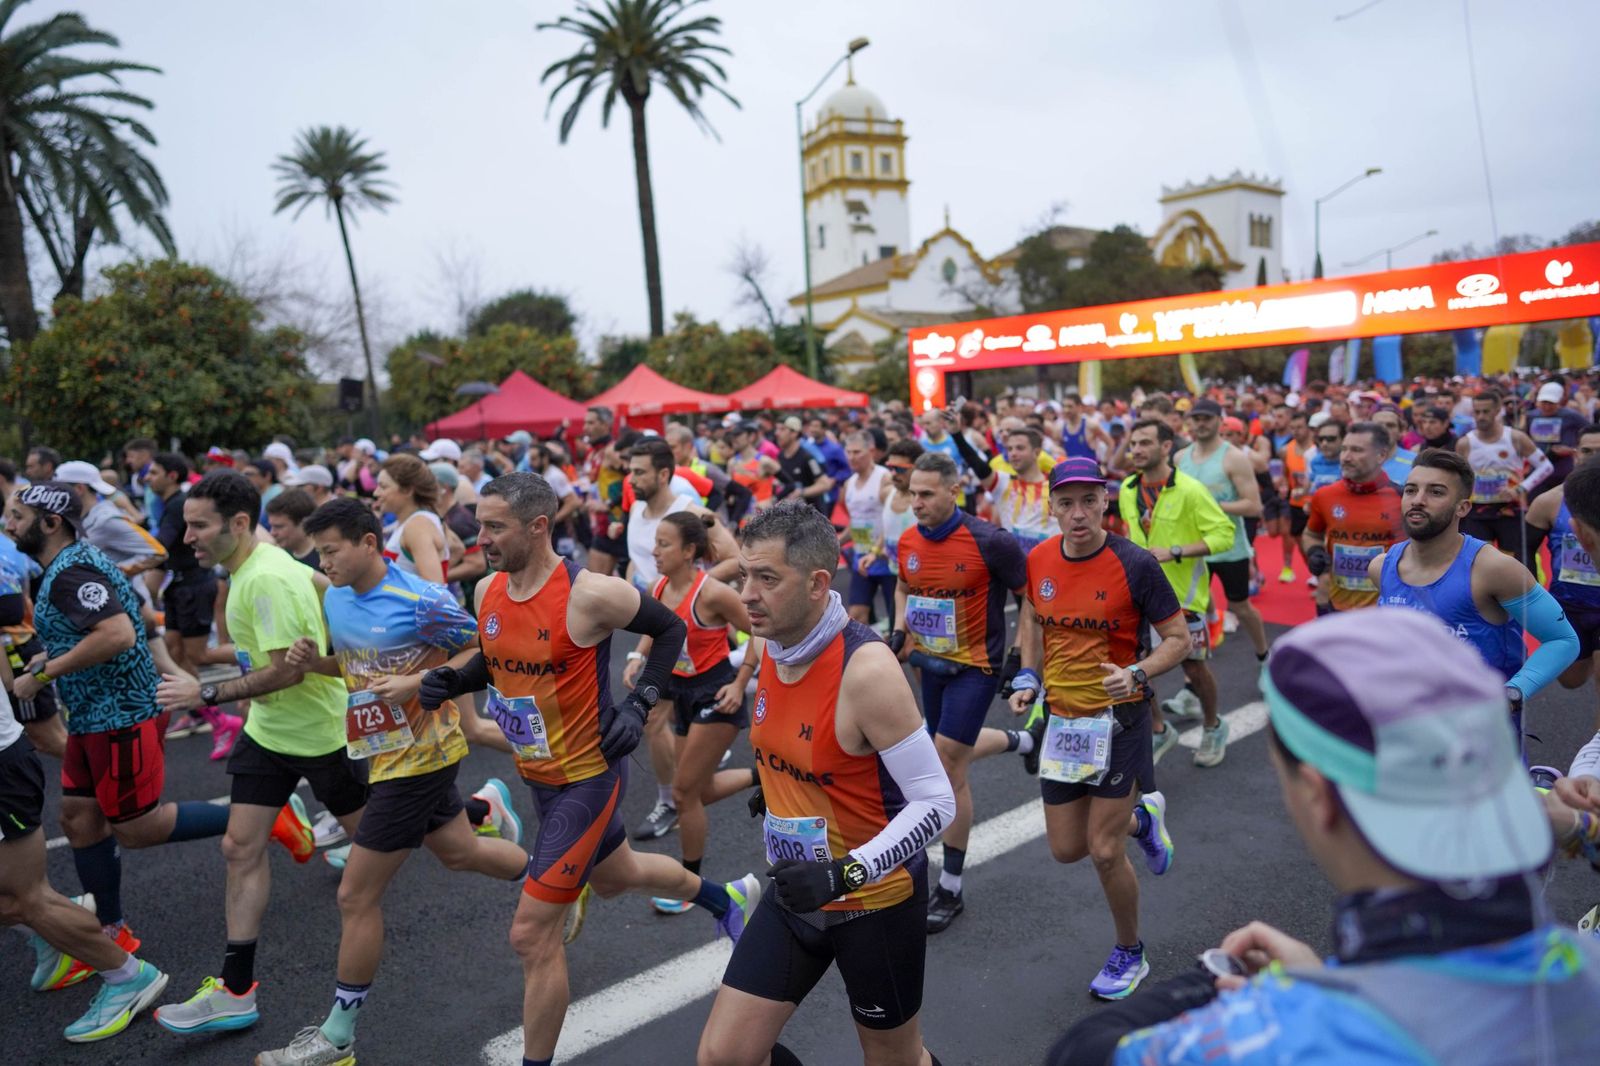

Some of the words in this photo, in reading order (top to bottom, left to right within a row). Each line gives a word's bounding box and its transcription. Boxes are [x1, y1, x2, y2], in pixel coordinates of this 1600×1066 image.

[911, 610, 942, 629] 2957
[1060, 616, 1121, 632] CAMAS
[504, 659, 567, 676] CAMAS
[353, 705, 385, 730] 723
[1055, 732, 1090, 753] 2834
[769, 754, 834, 787] CAMAS
